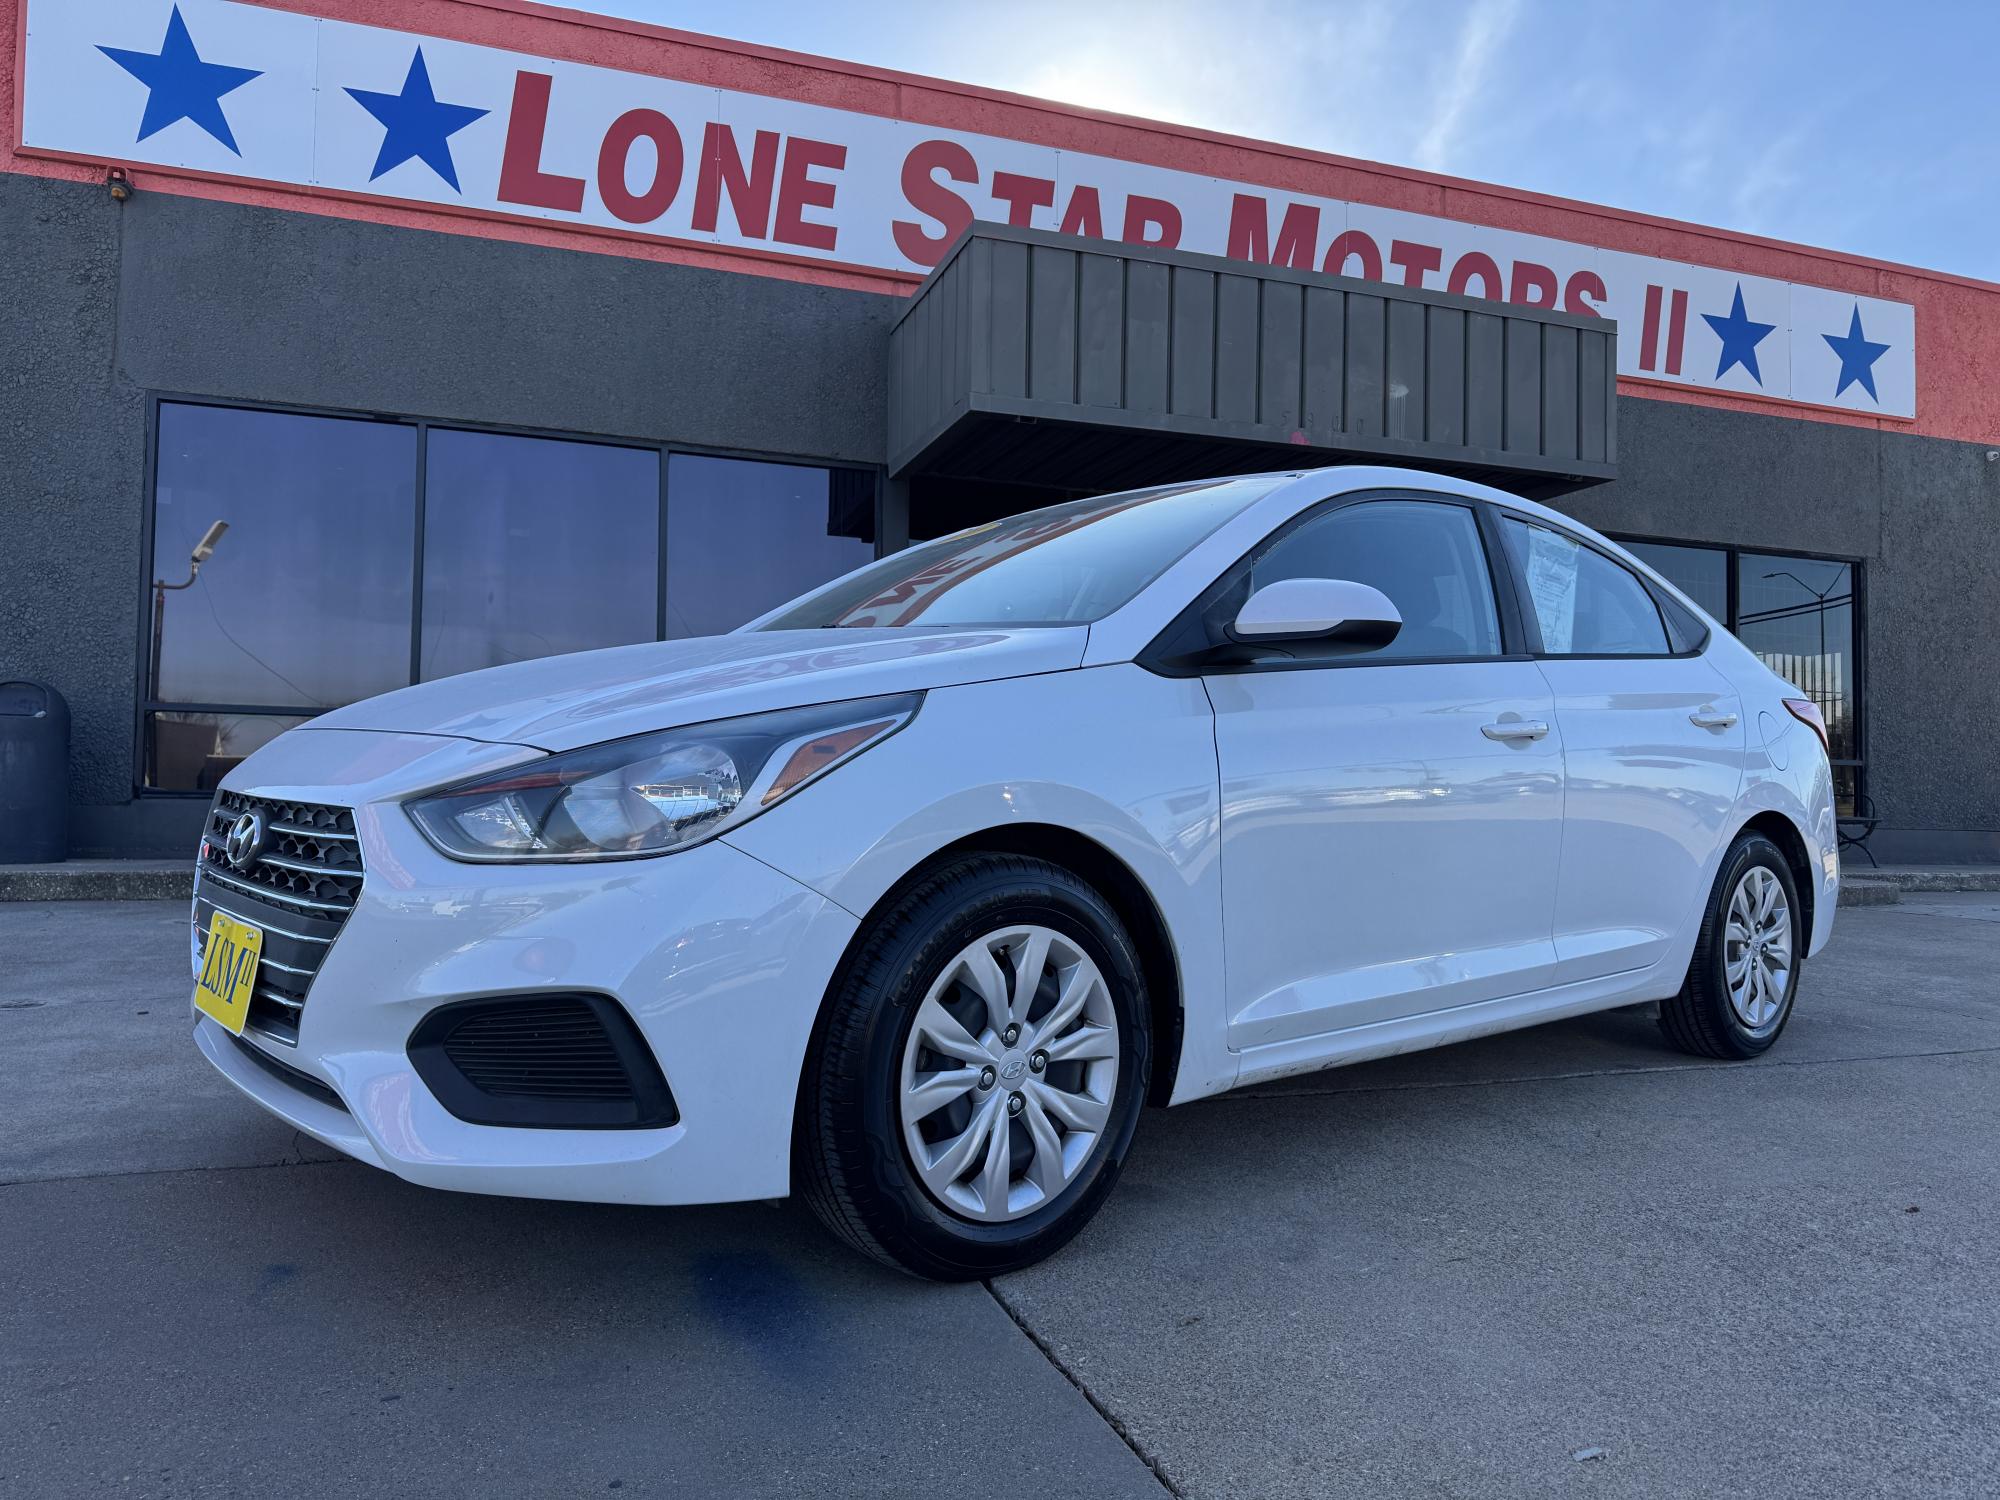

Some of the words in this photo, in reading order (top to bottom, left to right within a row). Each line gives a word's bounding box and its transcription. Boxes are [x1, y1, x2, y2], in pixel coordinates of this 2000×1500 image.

[497, 70, 848, 252] LONE
[1638, 284, 1689, 376] II
[201, 932, 249, 1004] LSM
